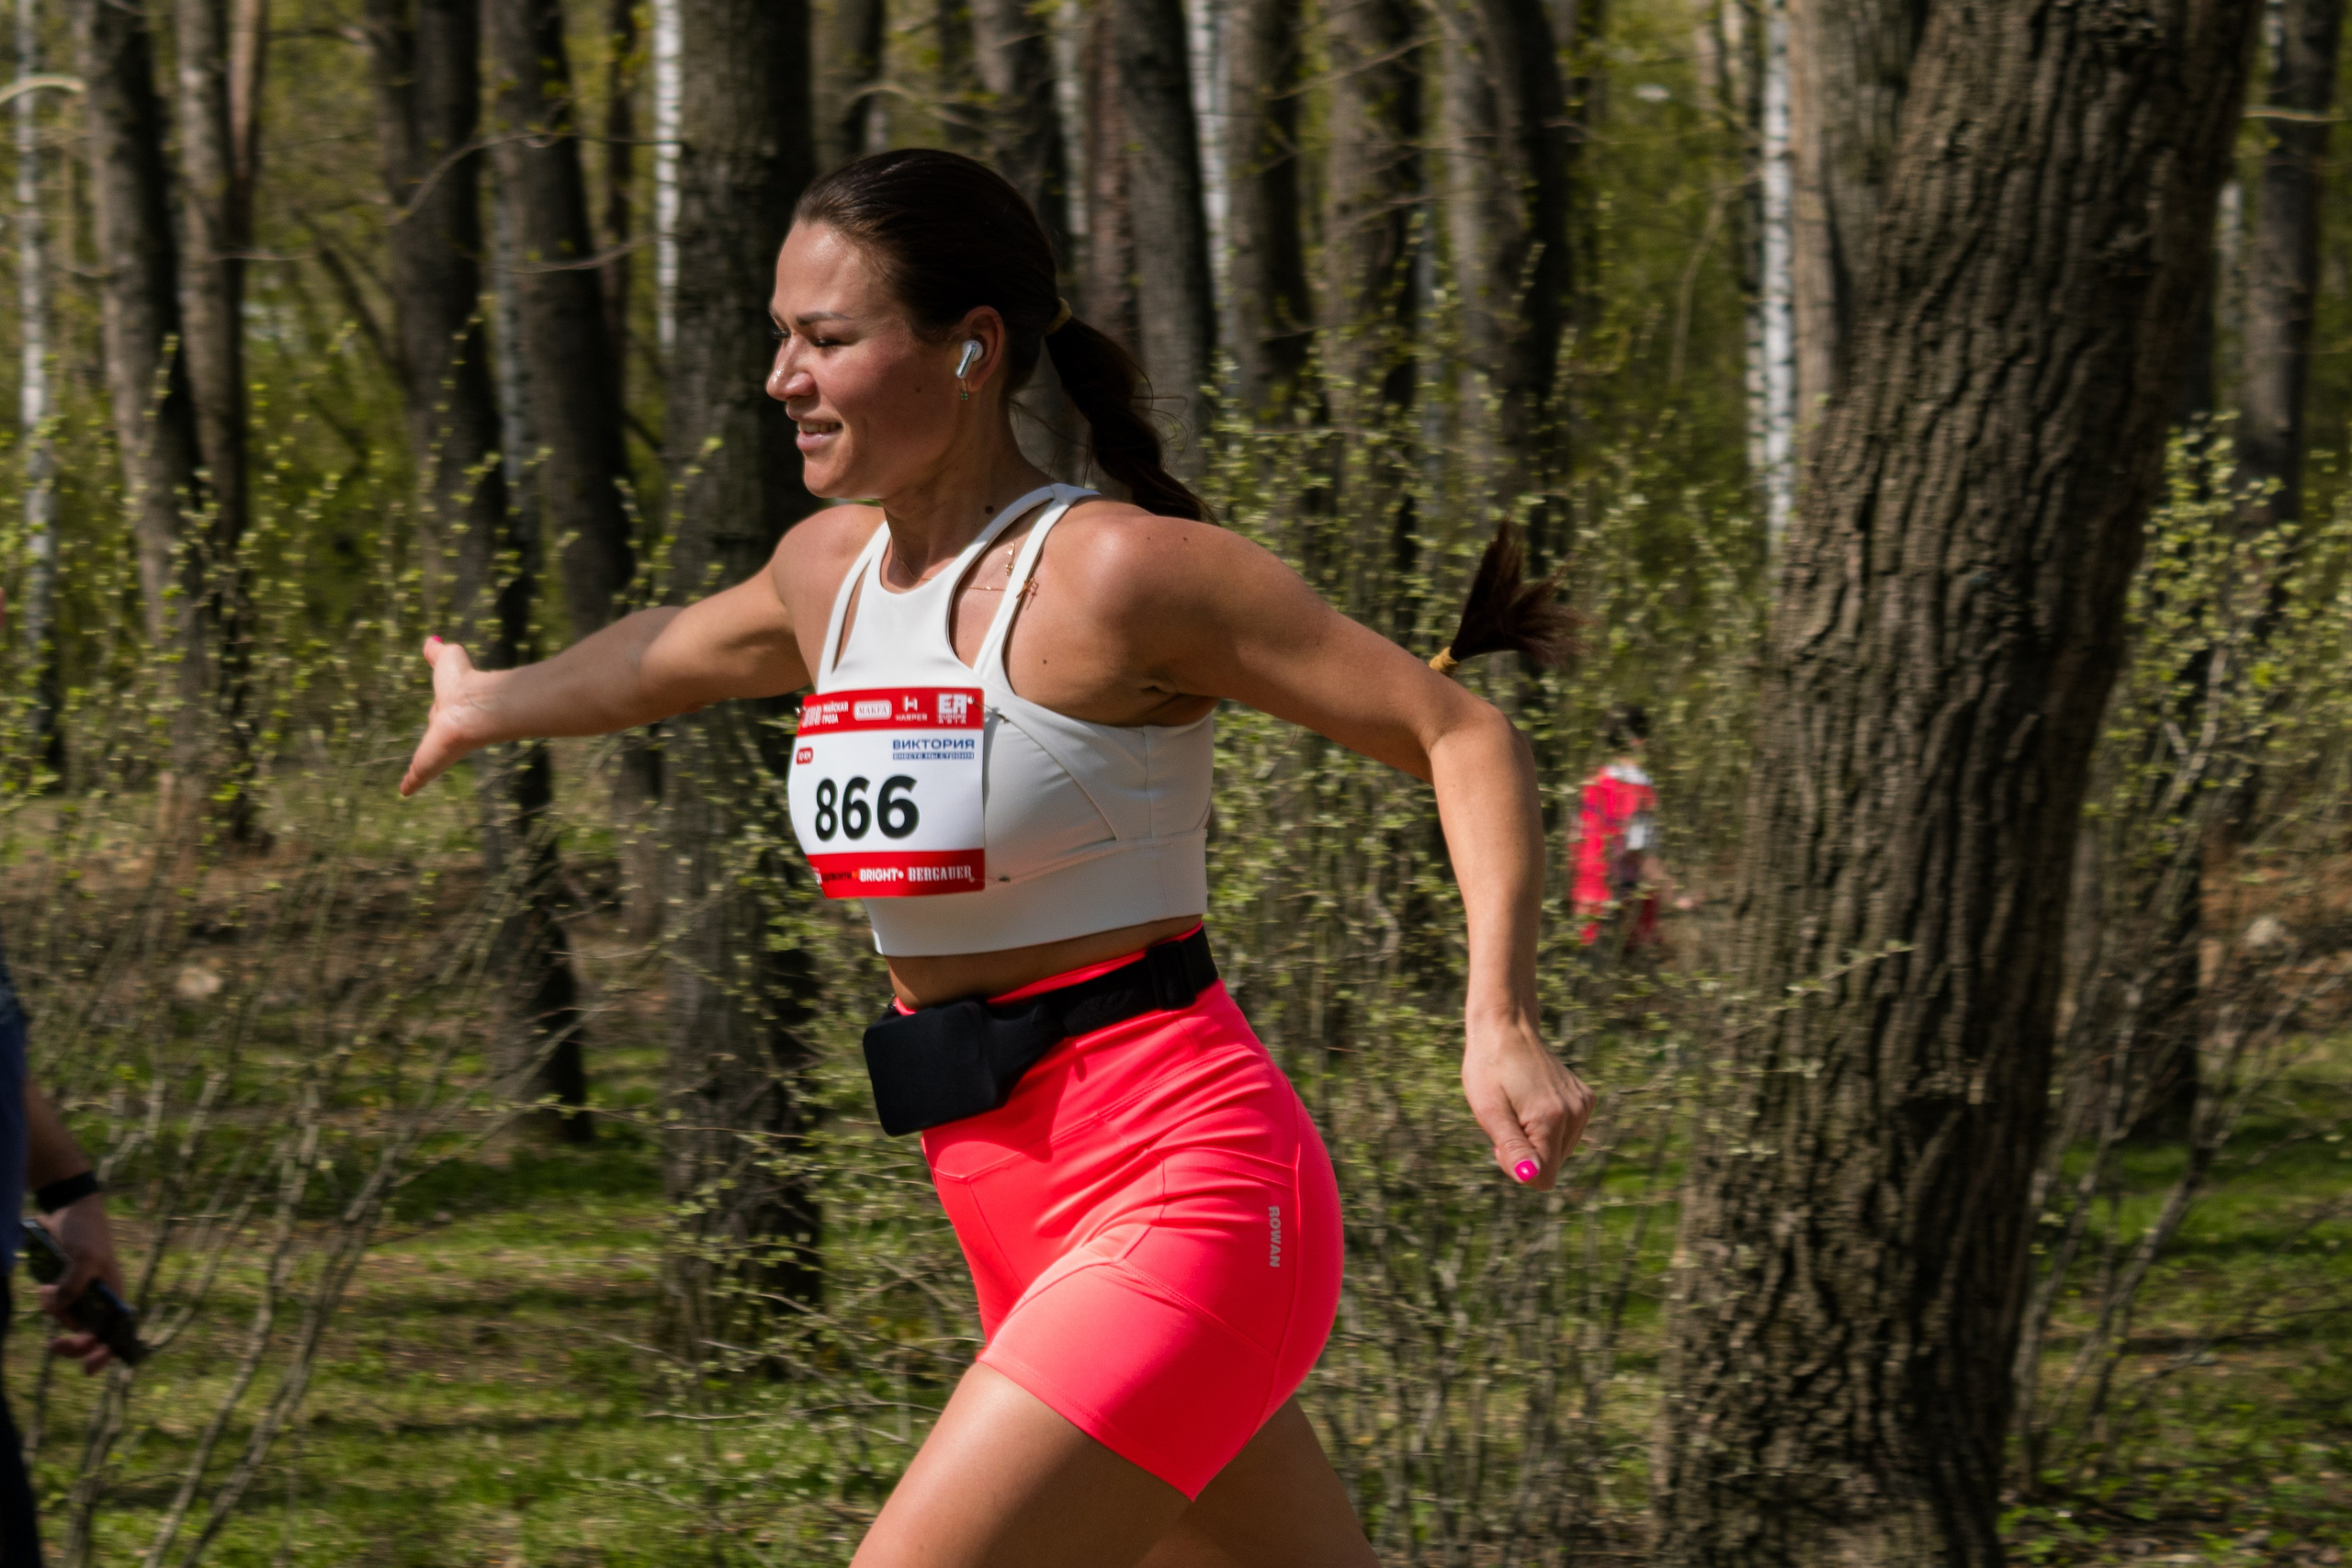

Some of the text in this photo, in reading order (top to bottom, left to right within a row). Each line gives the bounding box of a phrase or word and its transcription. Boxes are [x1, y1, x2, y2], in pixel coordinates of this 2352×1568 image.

[893, 739, 975, 750] ВИКТОРИЯ
[816, 773, 920, 842] 866
[859, 867, 899, 882] BRIGHT
[908, 865, 974, 883] BERGAUER
[1268, 1205, 1282, 1268] ROWAN
